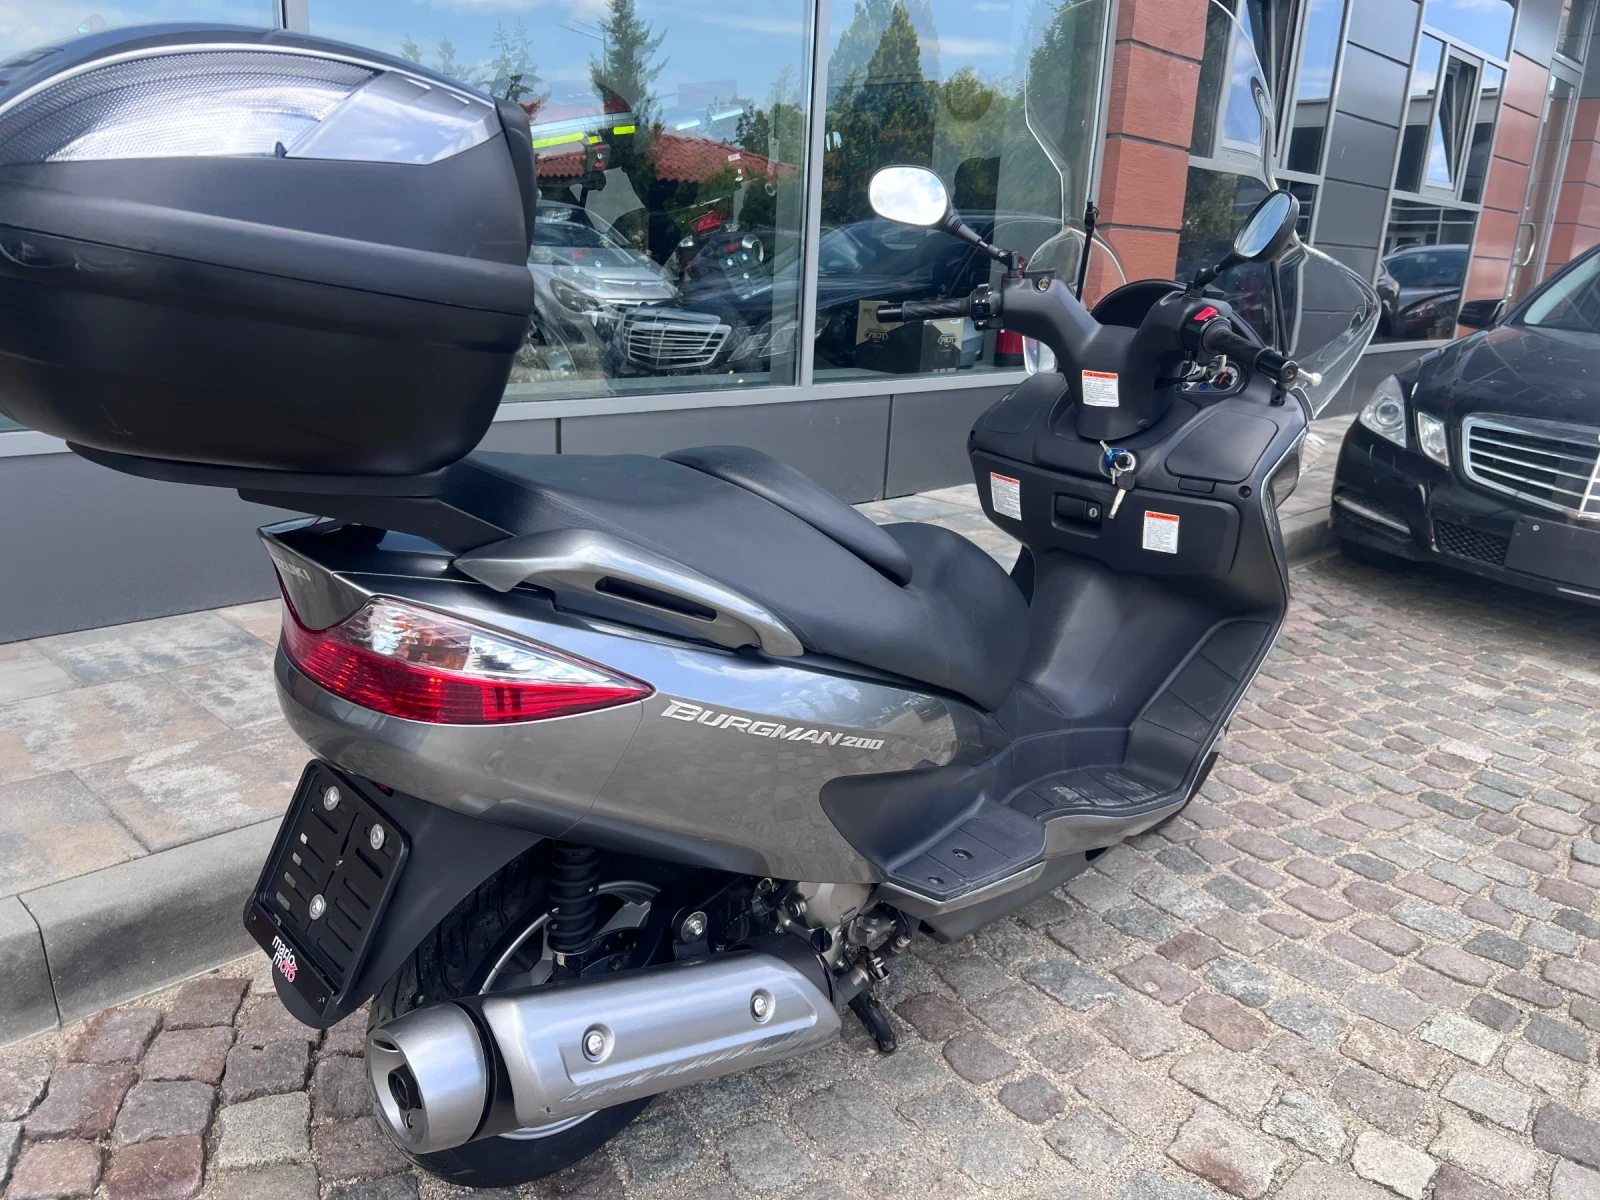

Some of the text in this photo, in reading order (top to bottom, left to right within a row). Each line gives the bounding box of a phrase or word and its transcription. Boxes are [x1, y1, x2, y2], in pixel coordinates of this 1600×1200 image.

[661, 699, 885, 750] BURGMAN 200
[271, 935, 296, 966] mario
[273, 951, 296, 982] moto
